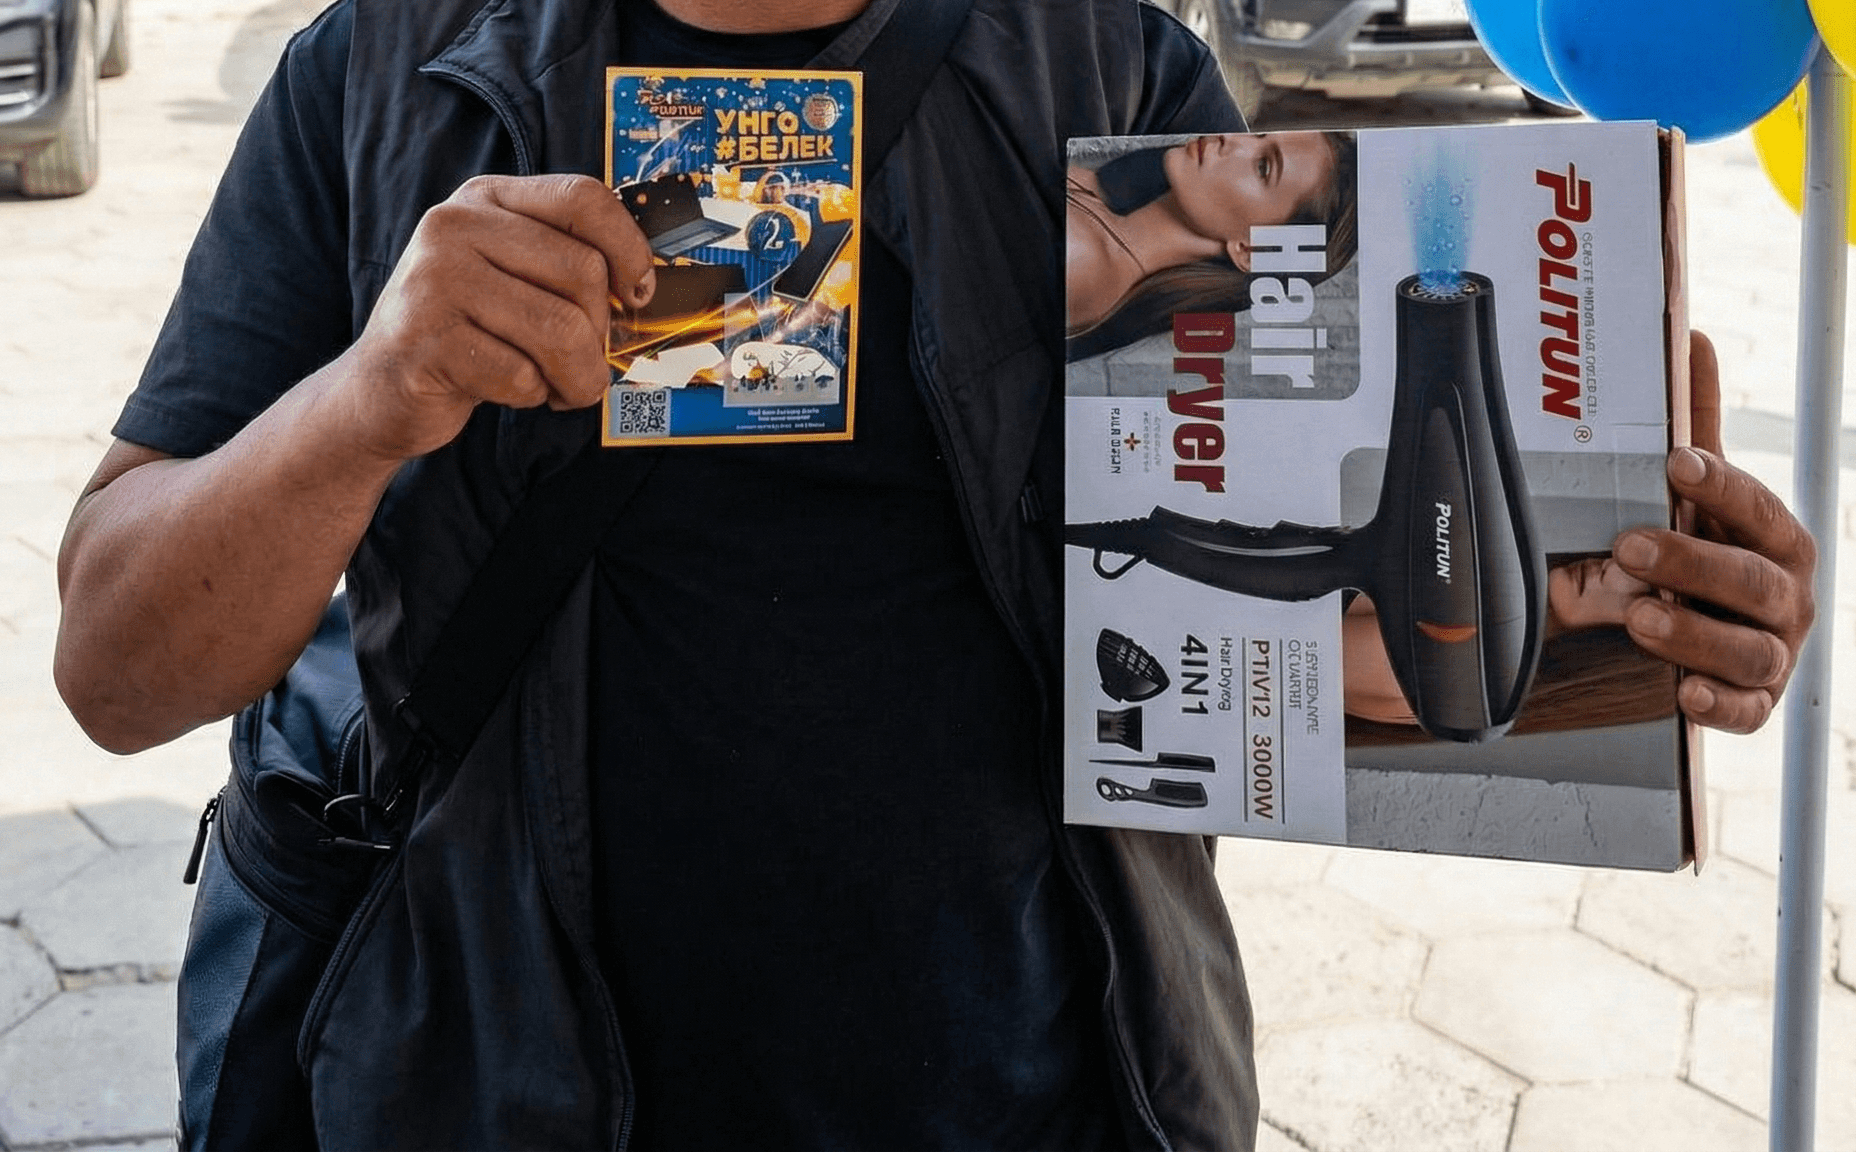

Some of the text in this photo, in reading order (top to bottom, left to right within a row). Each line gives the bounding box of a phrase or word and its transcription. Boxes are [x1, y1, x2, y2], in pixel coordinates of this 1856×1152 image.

[714, 134, 834, 161] #БЕЛЕК
[1249, 224, 1328, 388] Hair
[1168, 313, 1236, 493] Dryer
[1219, 637, 1234, 665] Hair
[1252, 733, 1274, 819] 3000W
